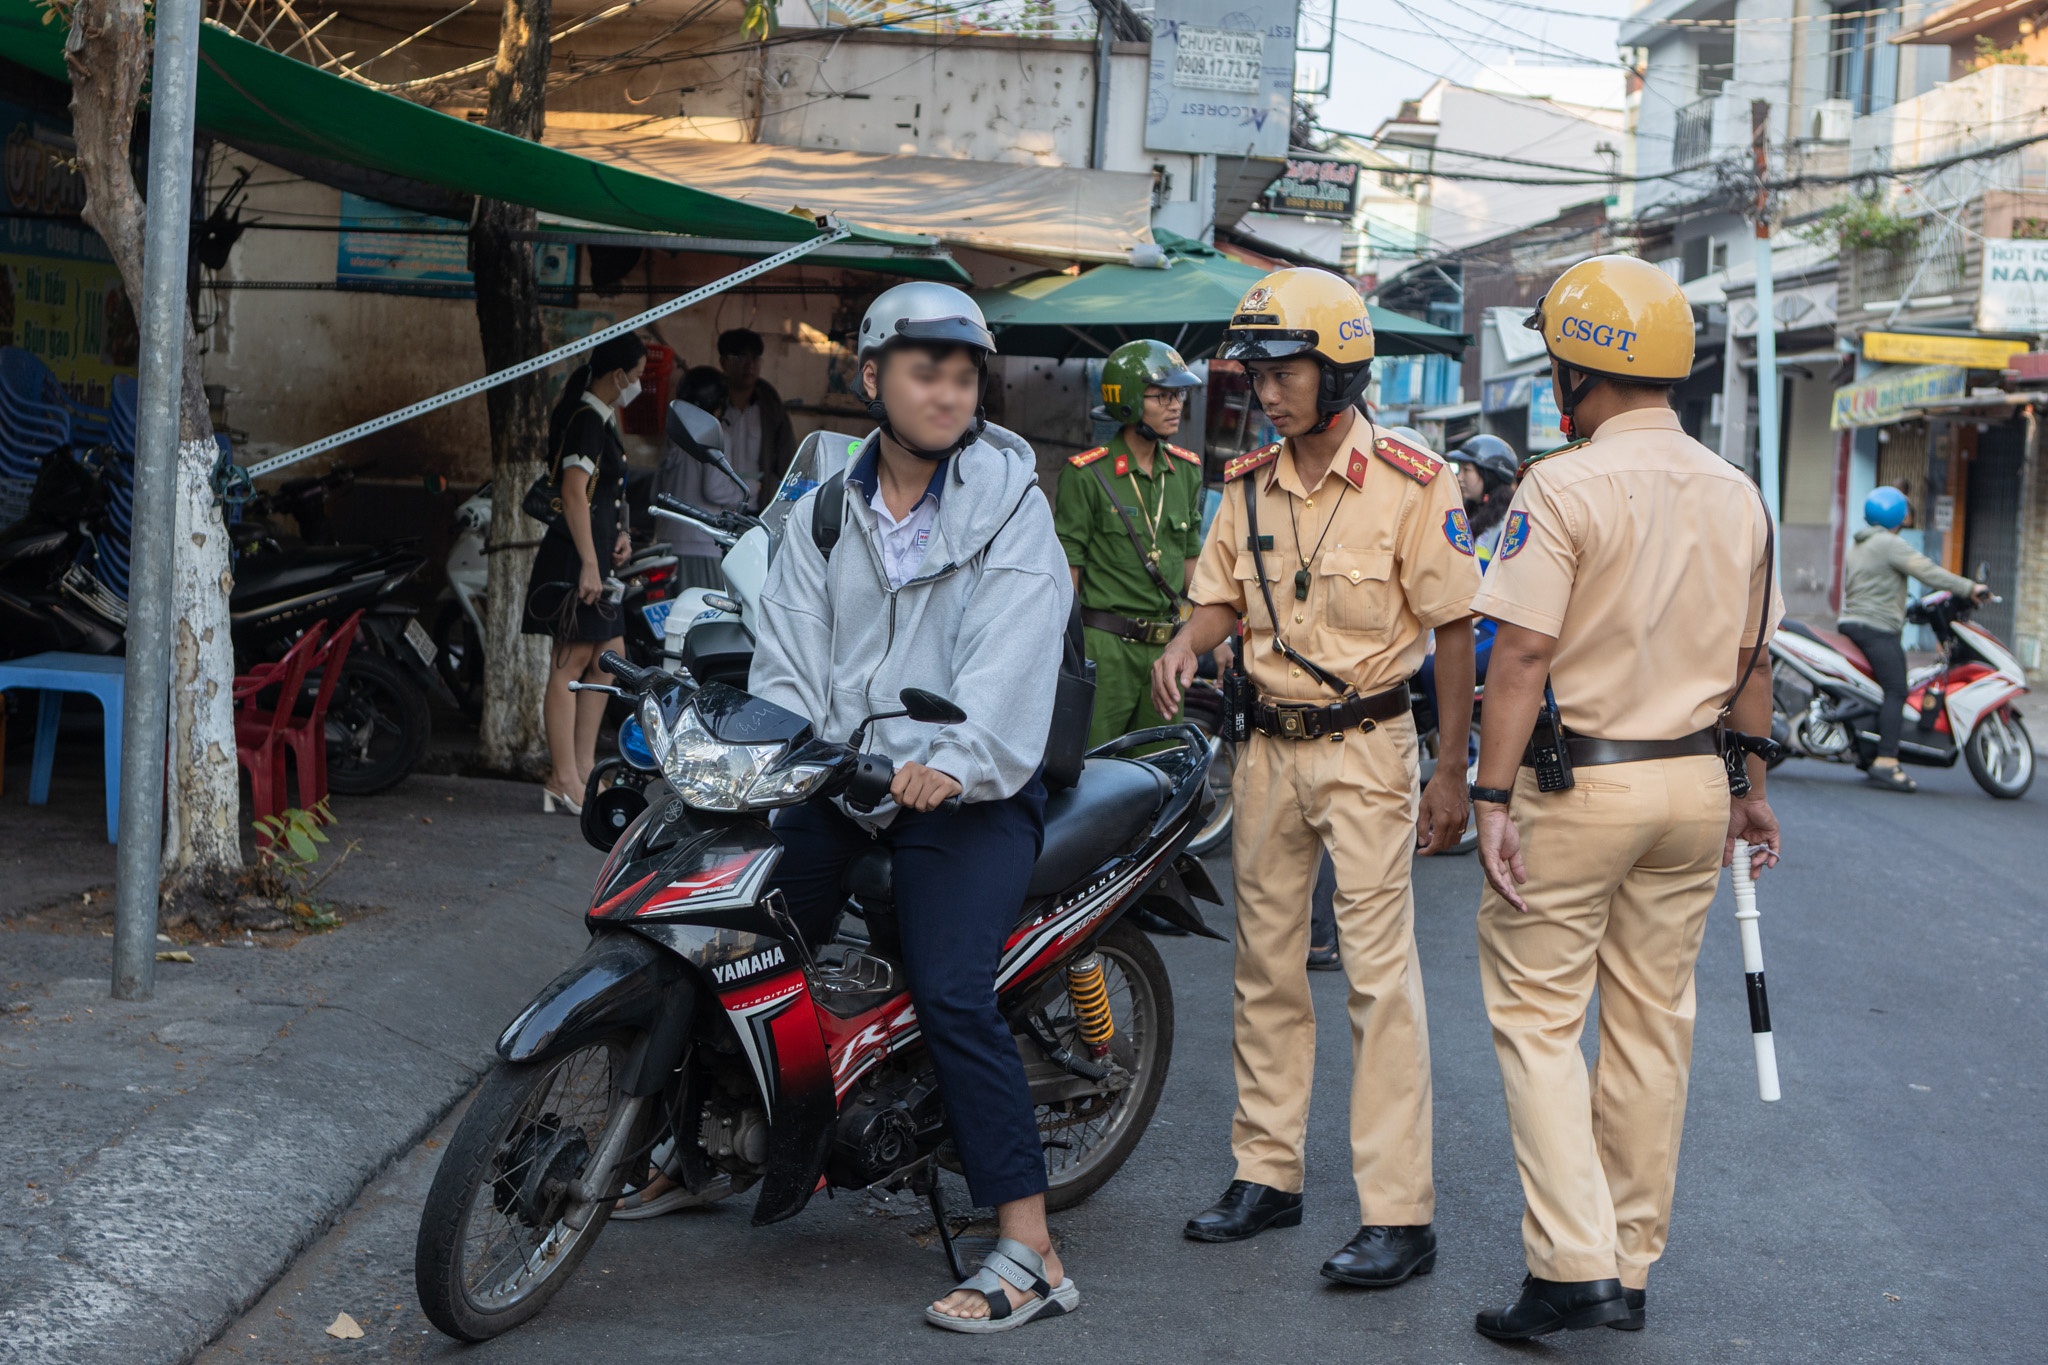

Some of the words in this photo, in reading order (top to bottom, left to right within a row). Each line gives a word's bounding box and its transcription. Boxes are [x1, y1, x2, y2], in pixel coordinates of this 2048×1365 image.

[1176, 56, 1261, 79] 0909.17.73.72
[1562, 316, 1637, 352] CSGT
[712, 946, 785, 984] YAMAHA
